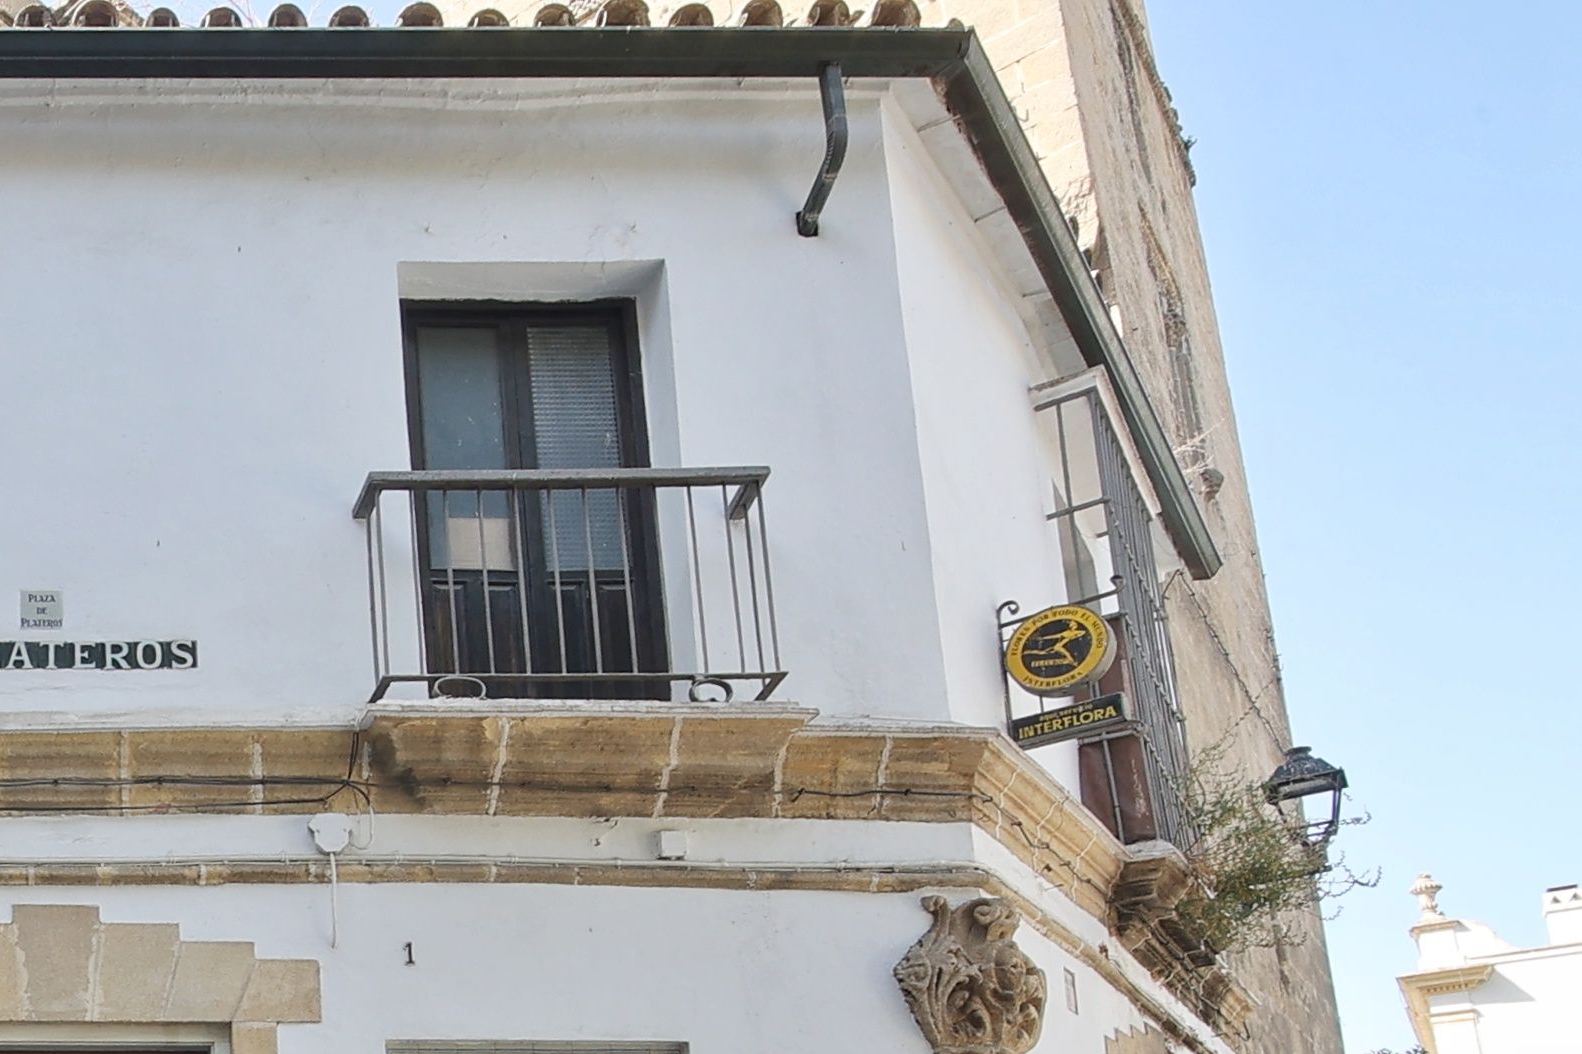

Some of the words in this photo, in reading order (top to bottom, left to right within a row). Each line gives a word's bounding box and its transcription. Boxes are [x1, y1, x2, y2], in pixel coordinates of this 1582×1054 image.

[36, 607, 48, 615] DE
[1022, 671, 1083, 688] INTERFLORA
[1018, 705, 1117, 739] INTERFLORA
